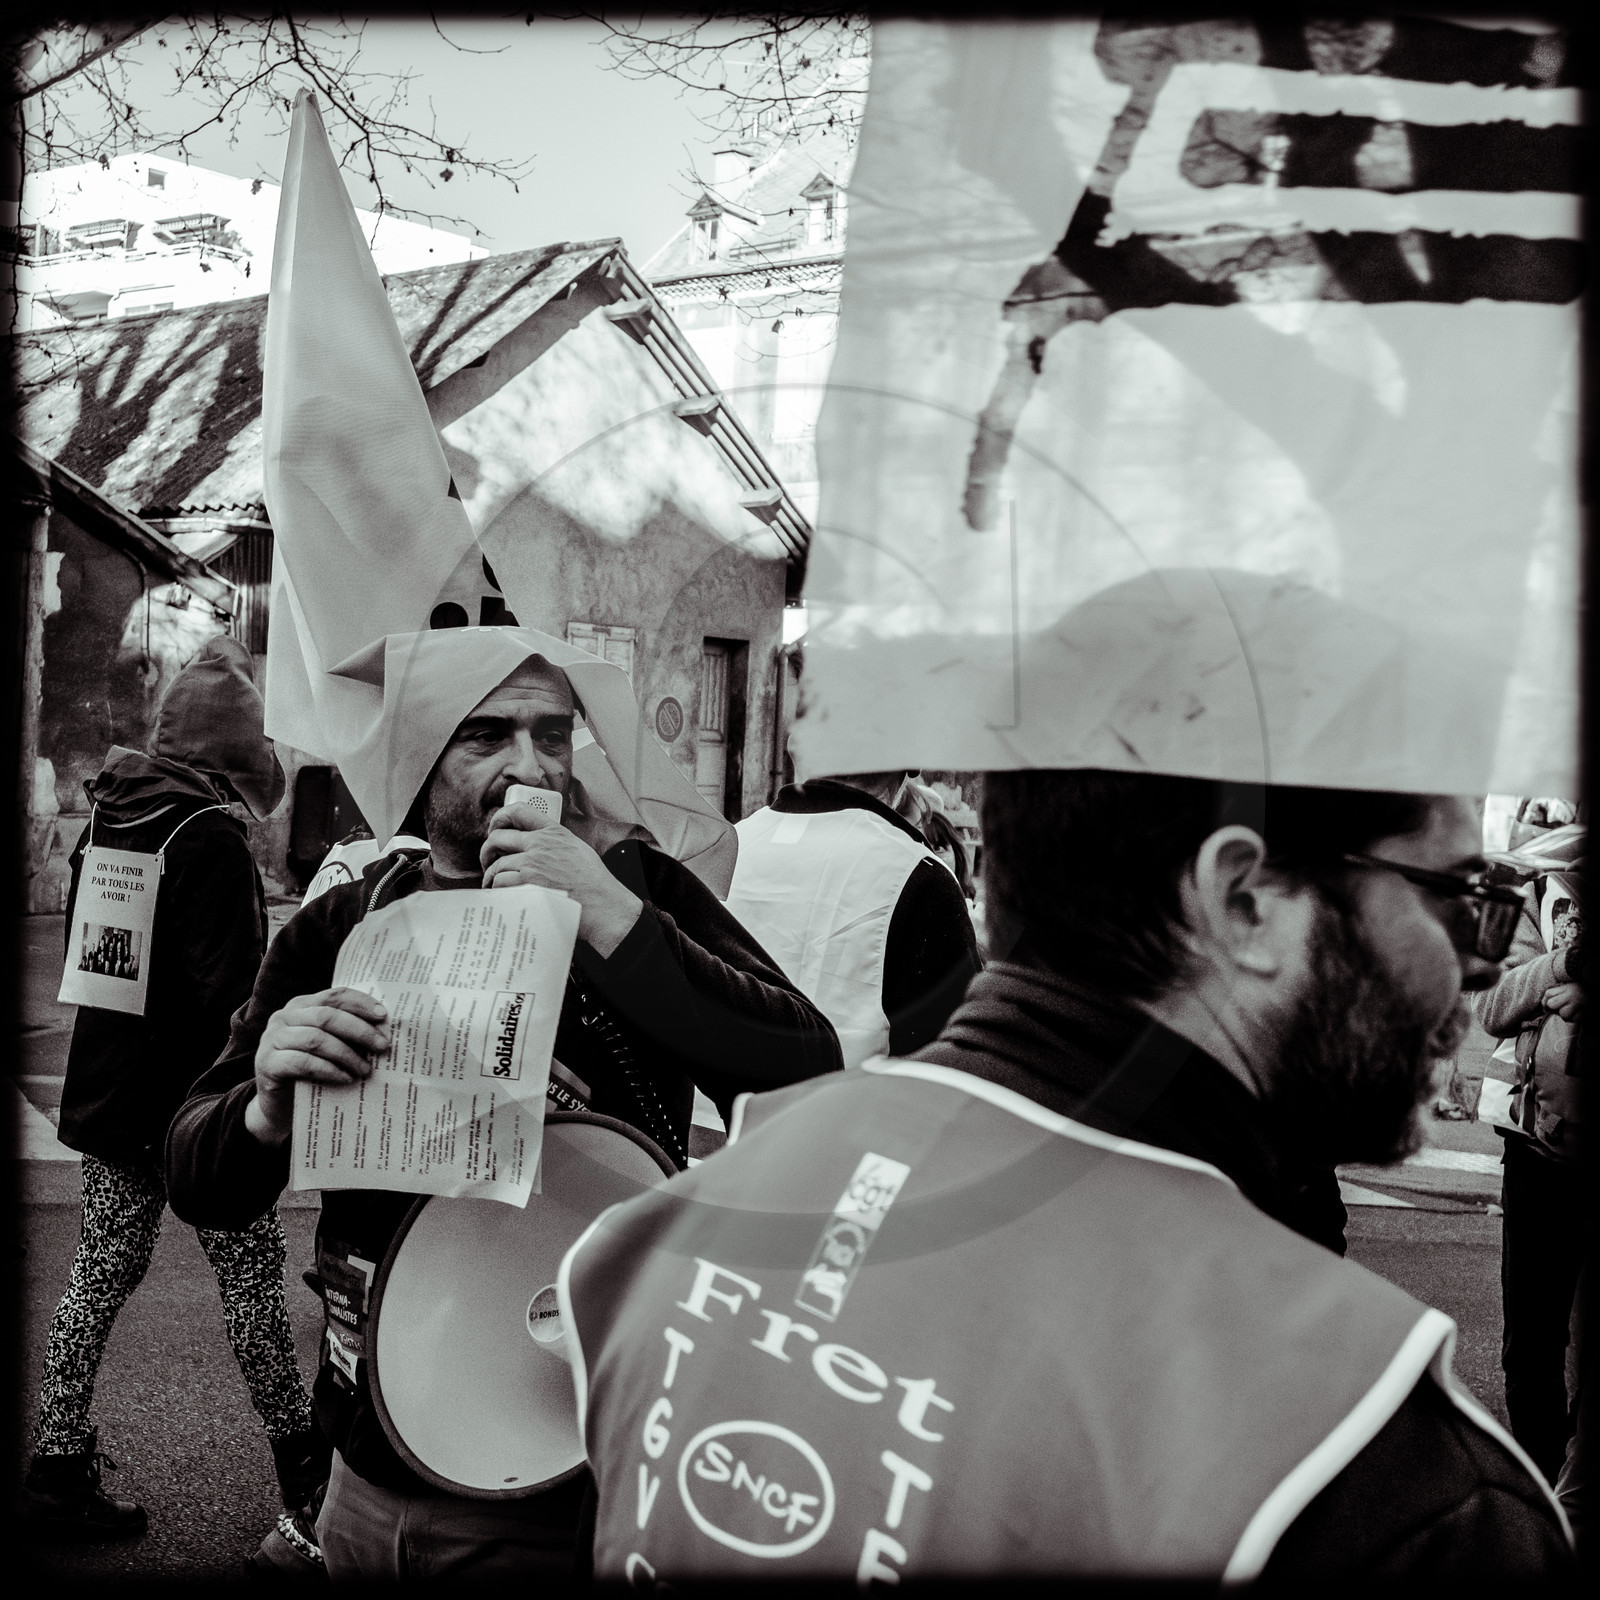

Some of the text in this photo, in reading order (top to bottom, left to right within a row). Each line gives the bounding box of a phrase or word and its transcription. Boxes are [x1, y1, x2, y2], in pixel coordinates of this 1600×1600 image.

[97, 862, 144, 878] ON VA FINIR
[91, 876, 145, 892] PAR TOUS LES
[100, 891, 126, 903] AVOIR
[493, 1003, 523, 1077] Solidaires
[556, 1089, 570, 1103] LE
[676, 1256, 956, 1443] Fret
[694, 1440, 820, 1534] SNCF
